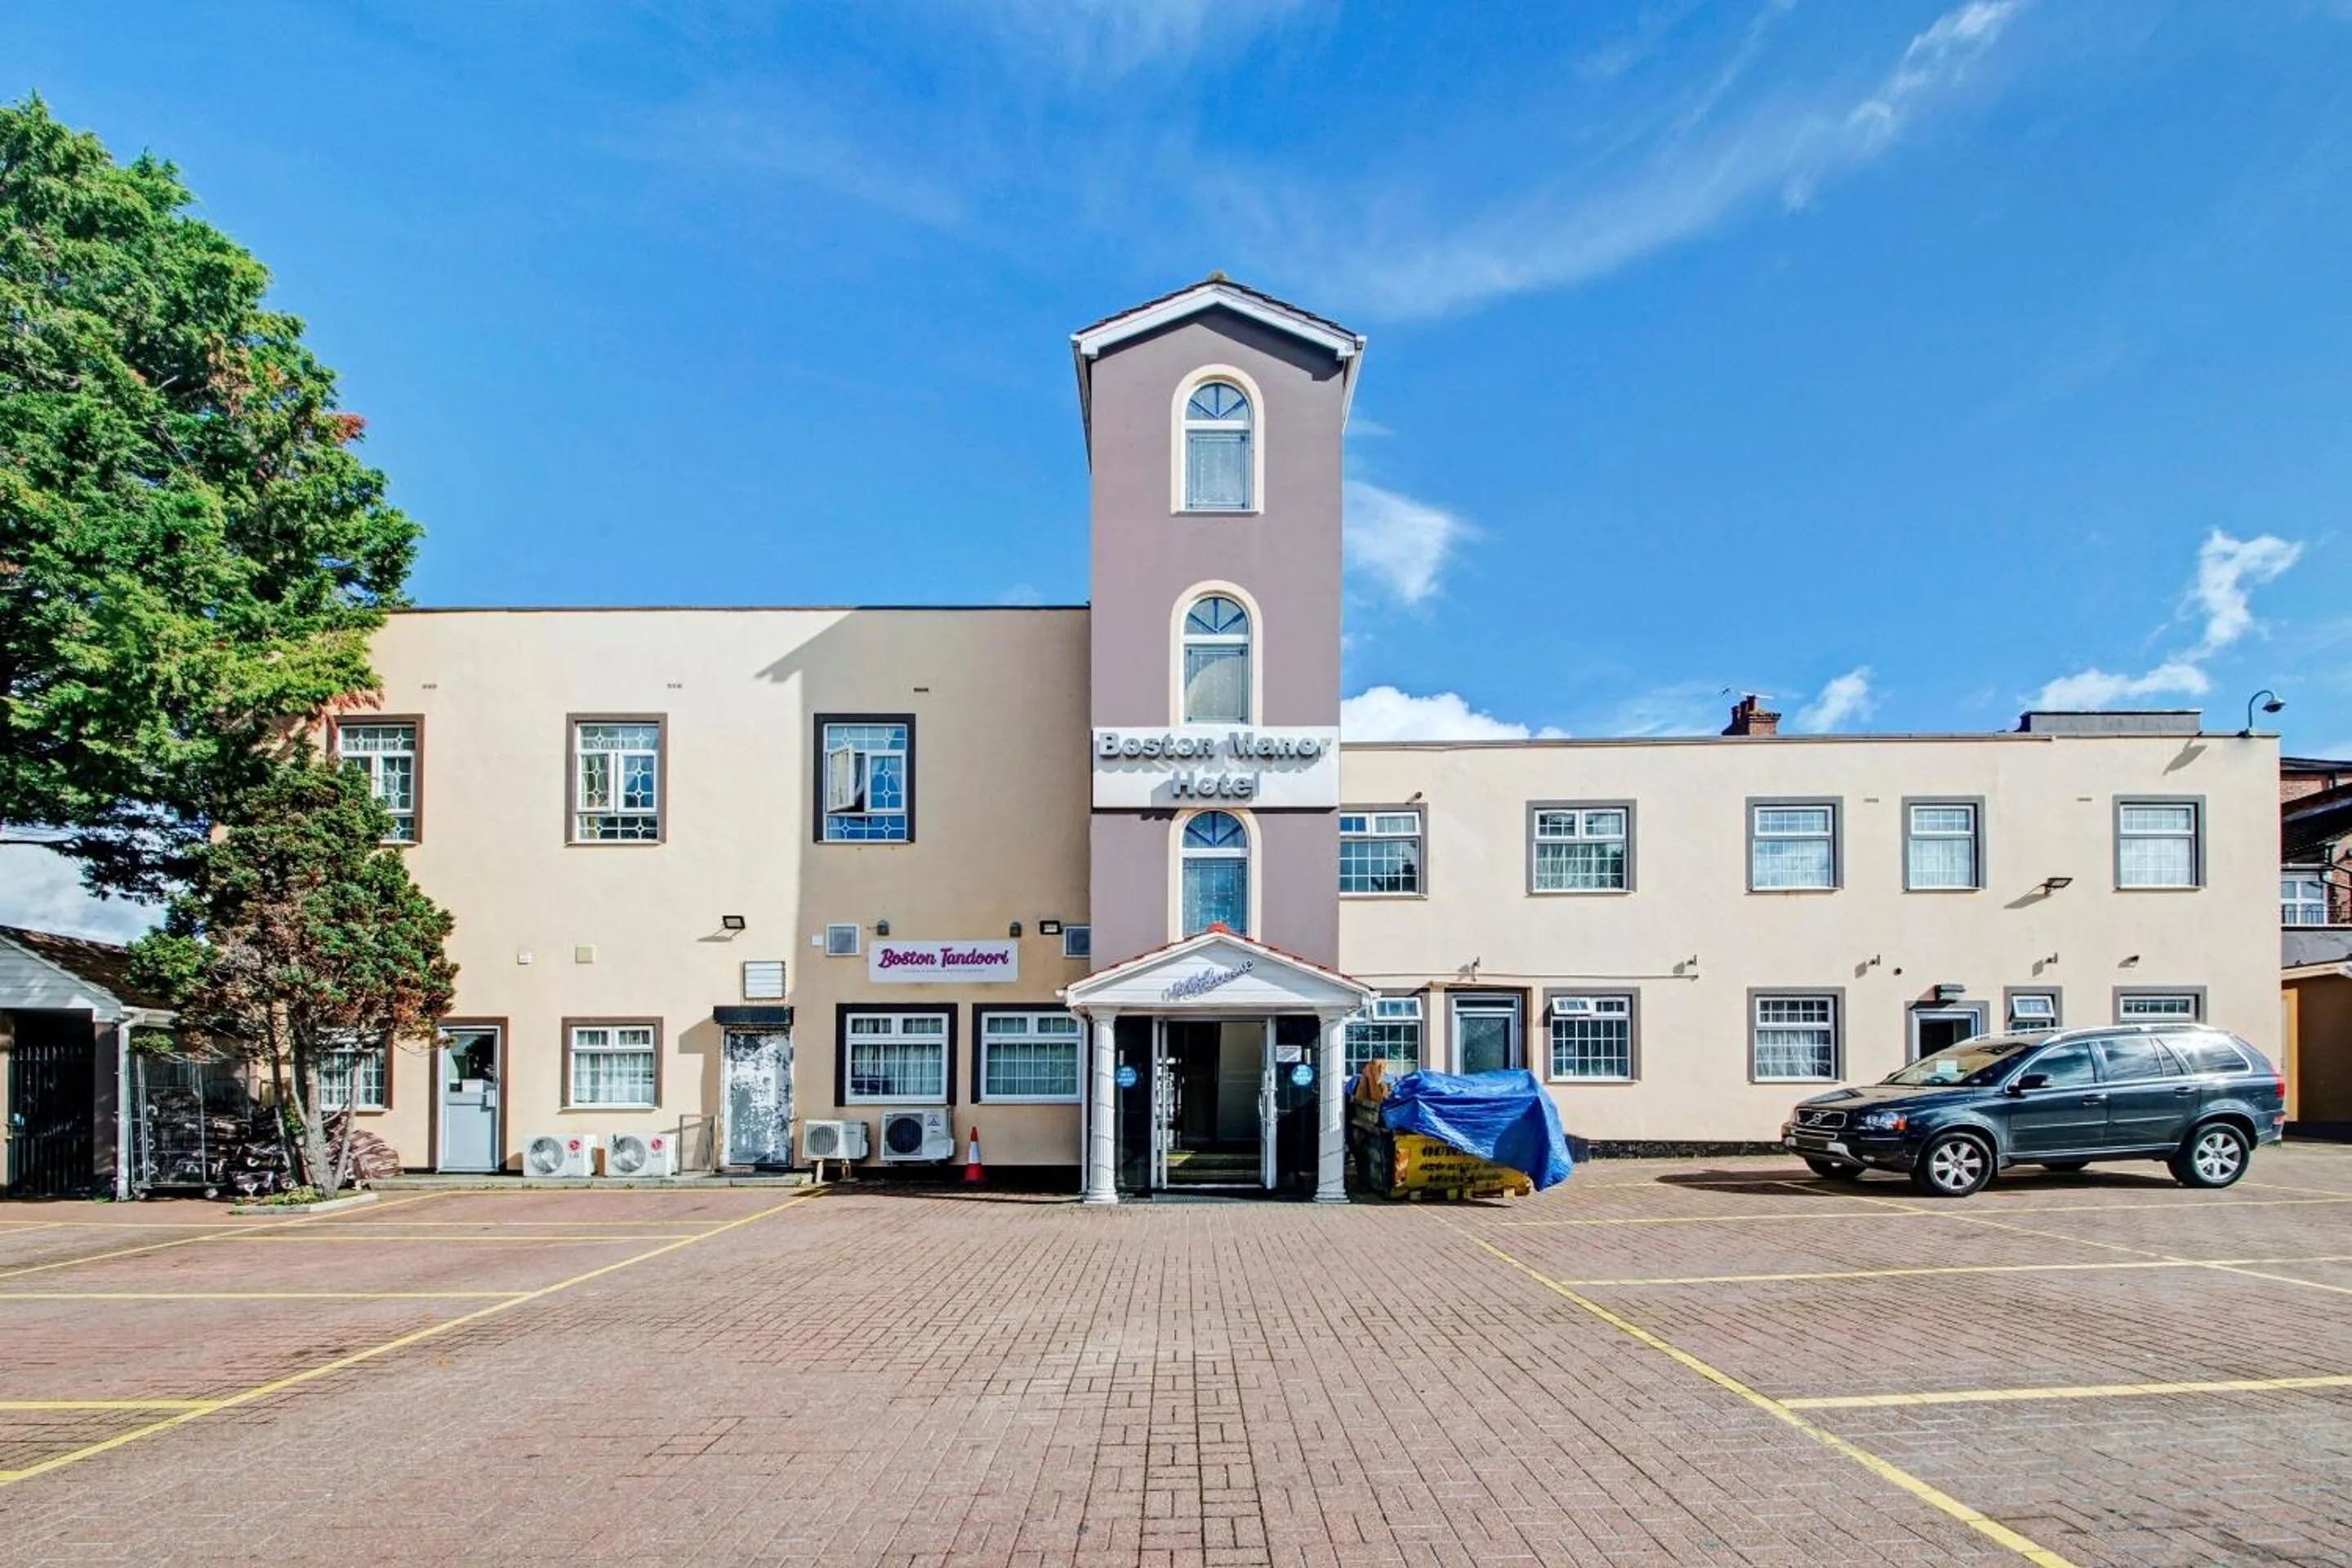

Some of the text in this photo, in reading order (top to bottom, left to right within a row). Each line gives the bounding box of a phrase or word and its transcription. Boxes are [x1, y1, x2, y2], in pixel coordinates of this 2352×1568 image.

[1098, 732, 1333, 759] Boston Manor
[1172, 770, 1260, 799] Hotel
[878, 947, 1009, 969] Boston Tandoori
